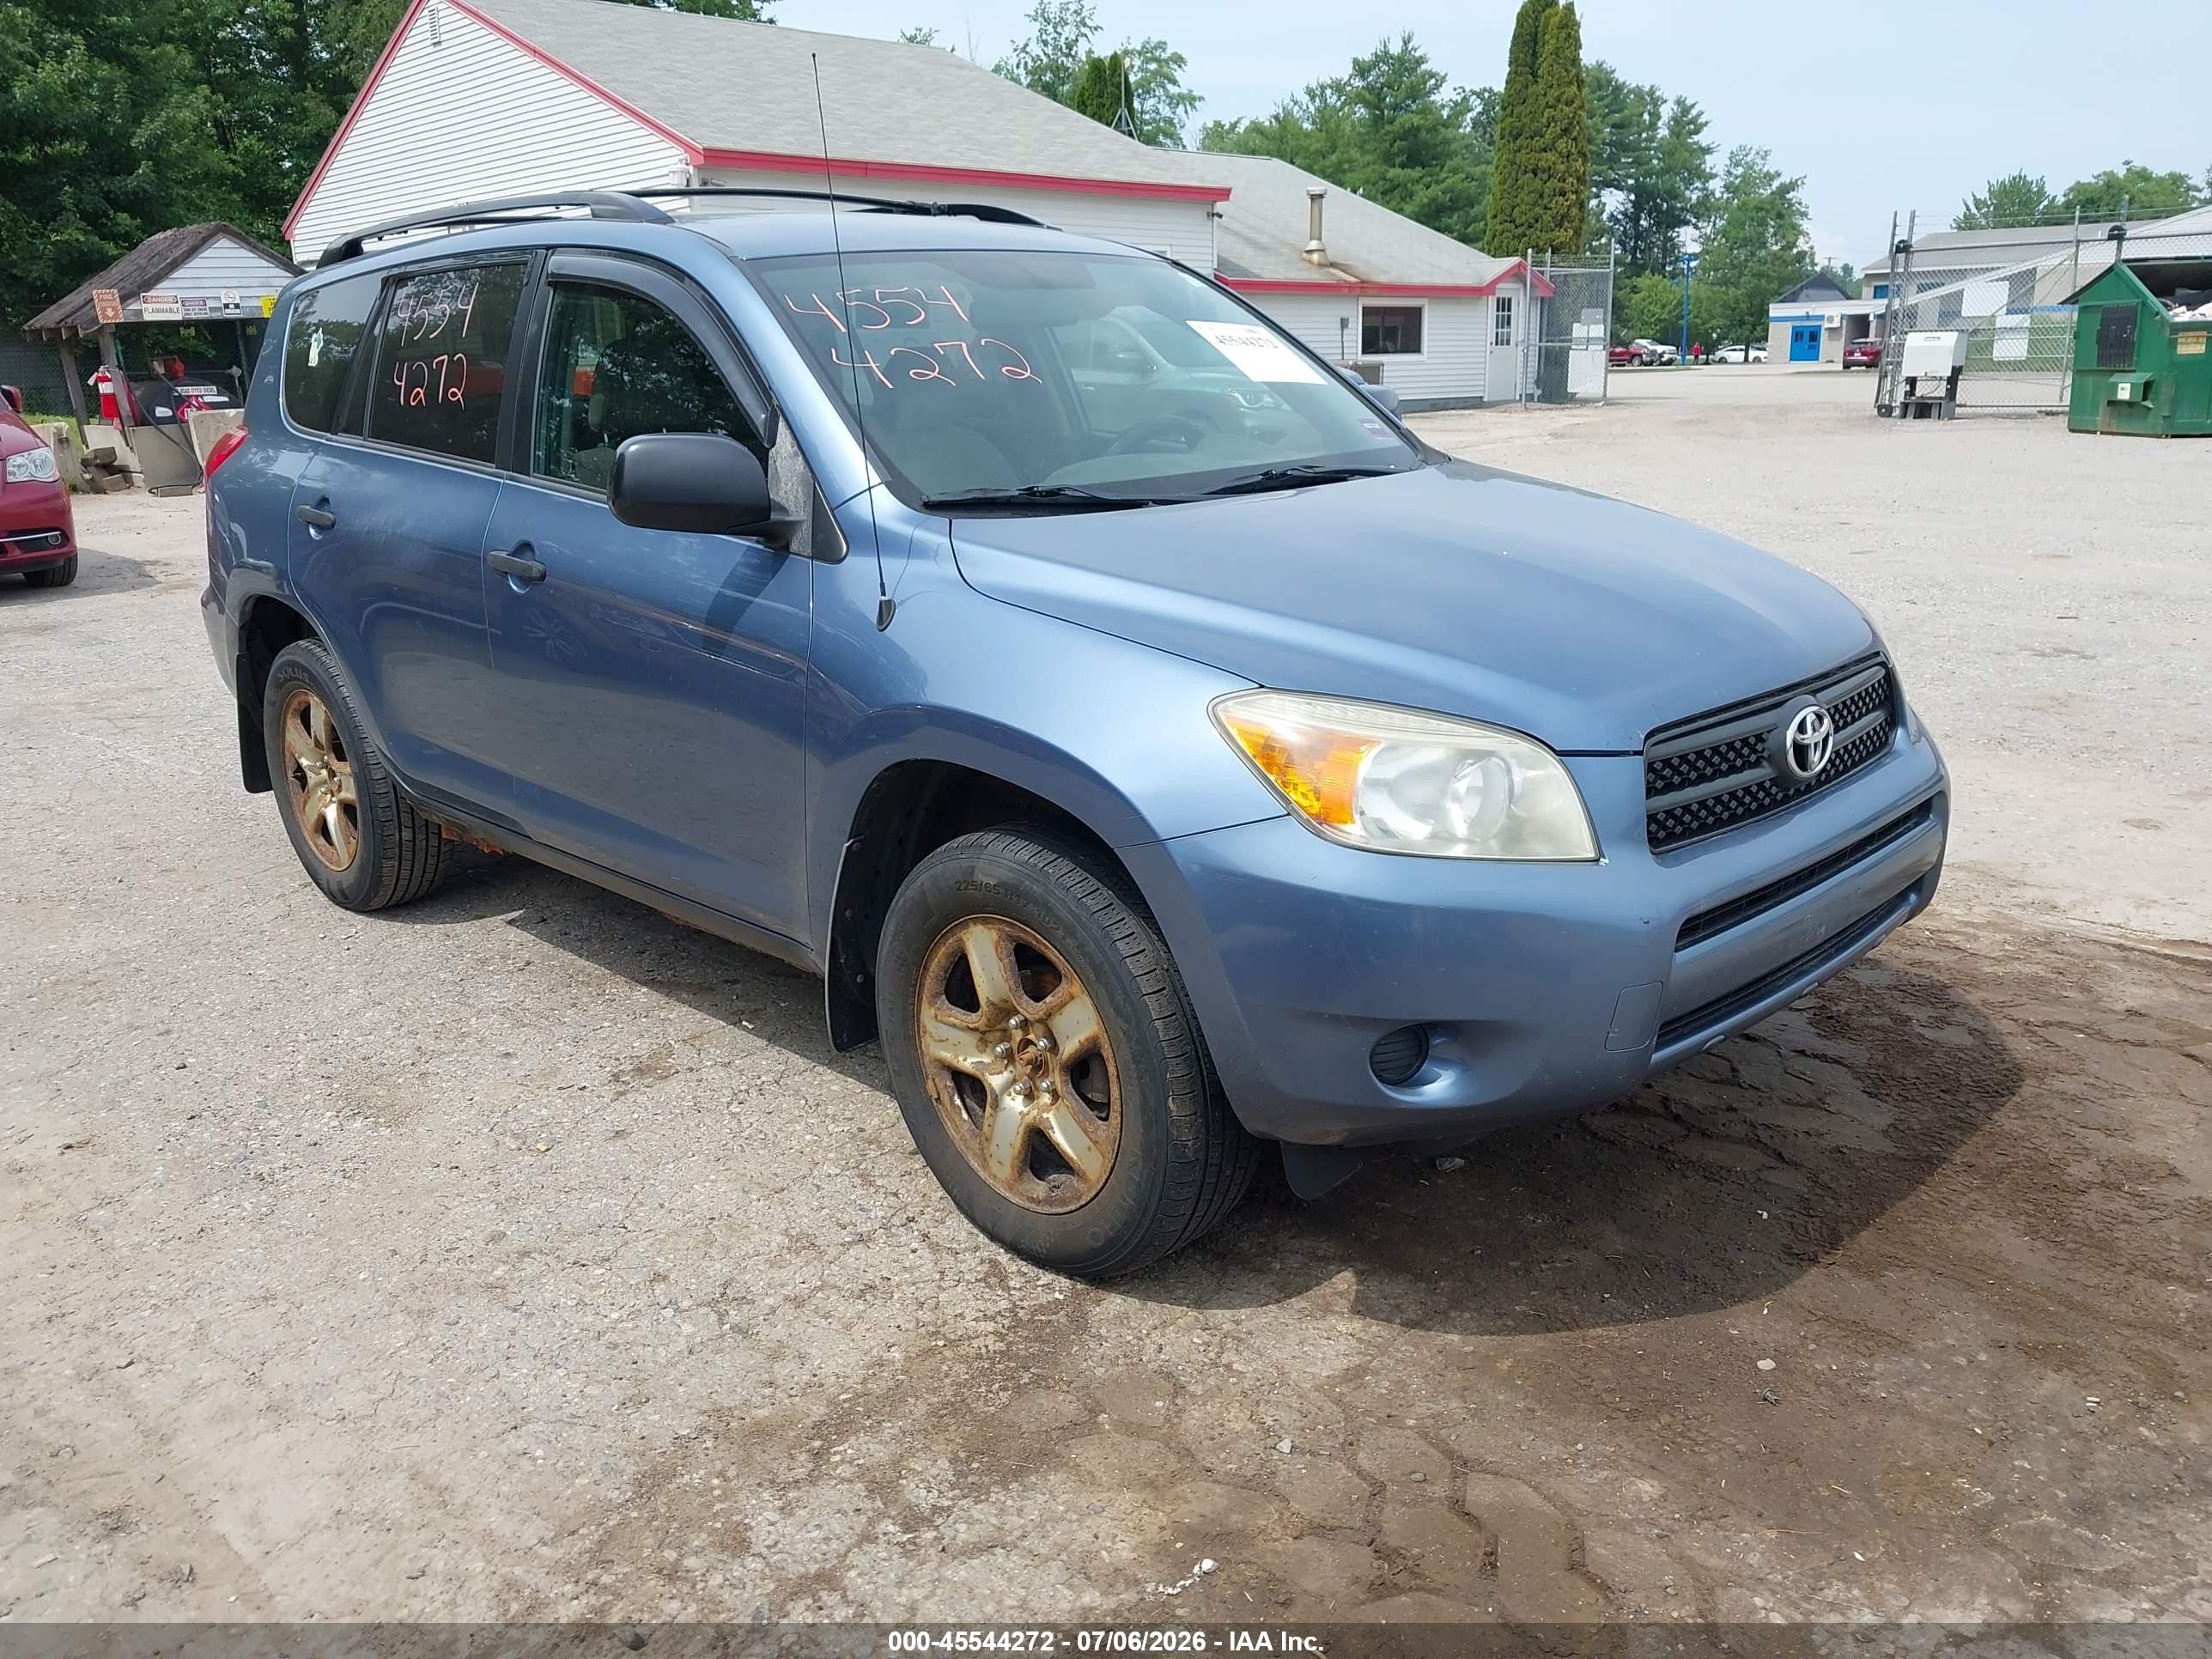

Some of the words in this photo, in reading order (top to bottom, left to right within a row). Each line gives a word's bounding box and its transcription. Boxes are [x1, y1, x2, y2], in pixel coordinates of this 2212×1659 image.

[397, 282, 479, 347] 4554
[783, 284, 969, 333] 4554
[830, 337, 1042, 388] 4272
[1214, 334, 1279, 349] 45544272
[392, 352, 468, 410] 4272
[276, 665, 310, 684] SOLUS
[954, 879, 1001, 896] 225/65
